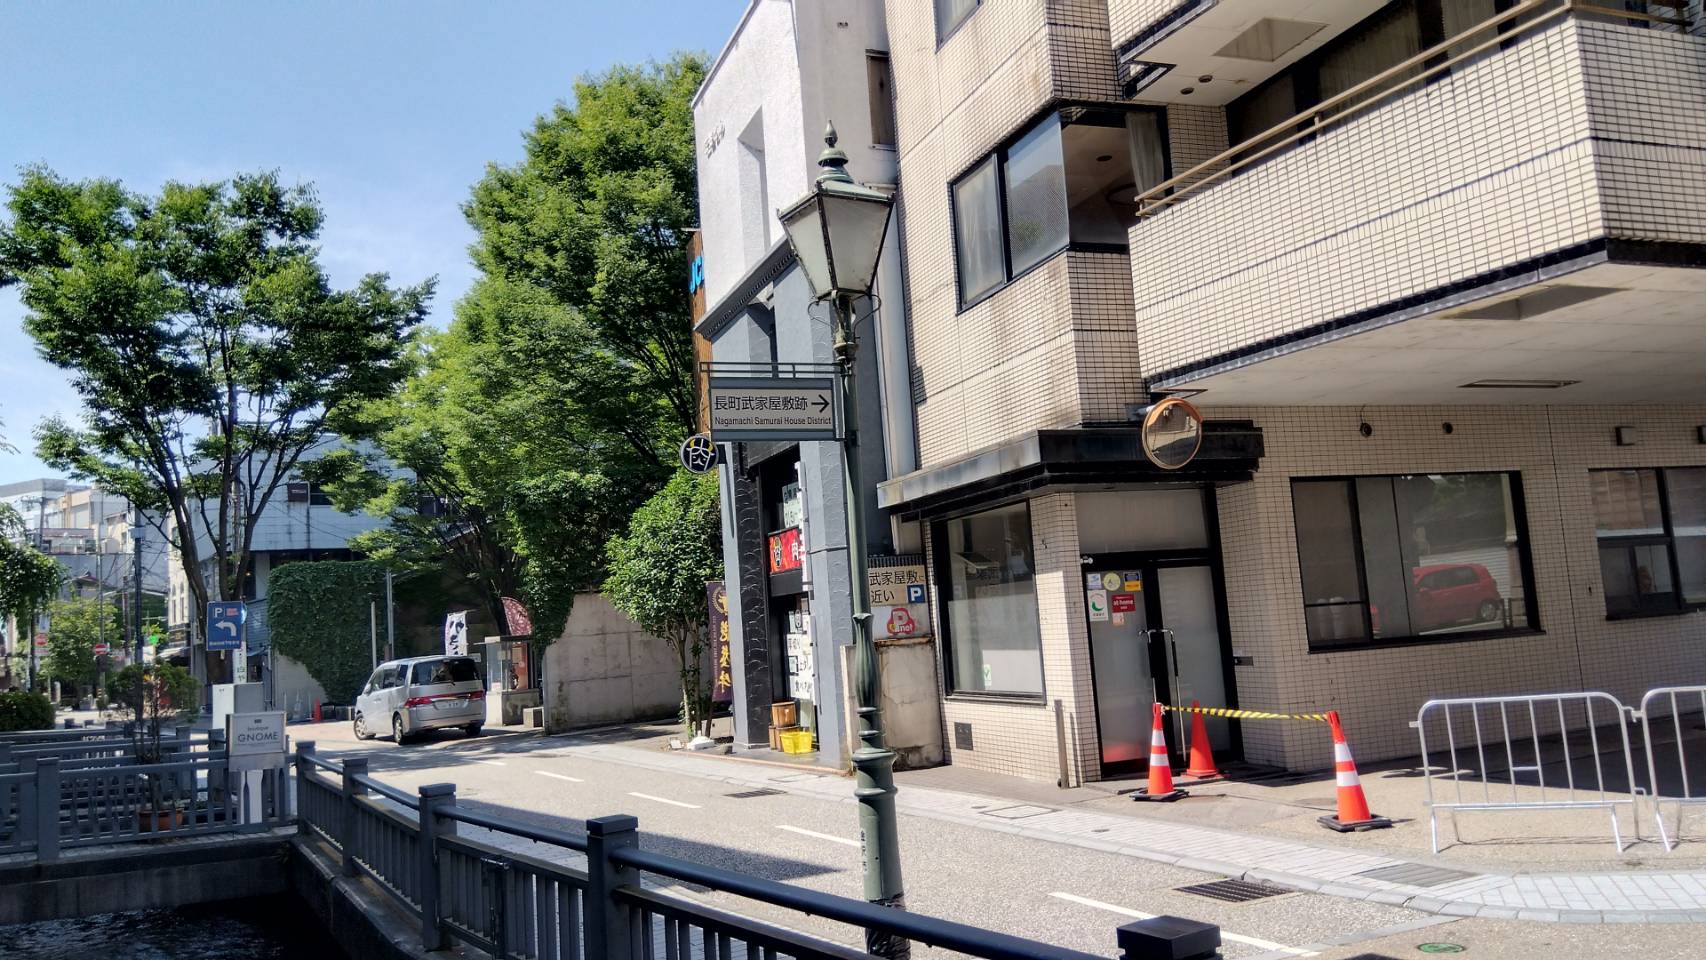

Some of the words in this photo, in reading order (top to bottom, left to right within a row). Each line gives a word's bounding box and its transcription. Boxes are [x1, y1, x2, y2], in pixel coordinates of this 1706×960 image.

[715, 395, 808, 411] 長町武家屋敷跡
[715, 416, 754, 427] Nagamachi
[754, 416, 783, 426] Samurai
[784, 416, 806, 425] House
[807, 416, 831, 425] District
[869, 570, 925, 586] 武家屋敷に
[870, 589, 895, 604] 近い
[909, 587, 922, 602] P
[214, 607, 223, 618] P
[238, 732, 279, 743] GNOME
